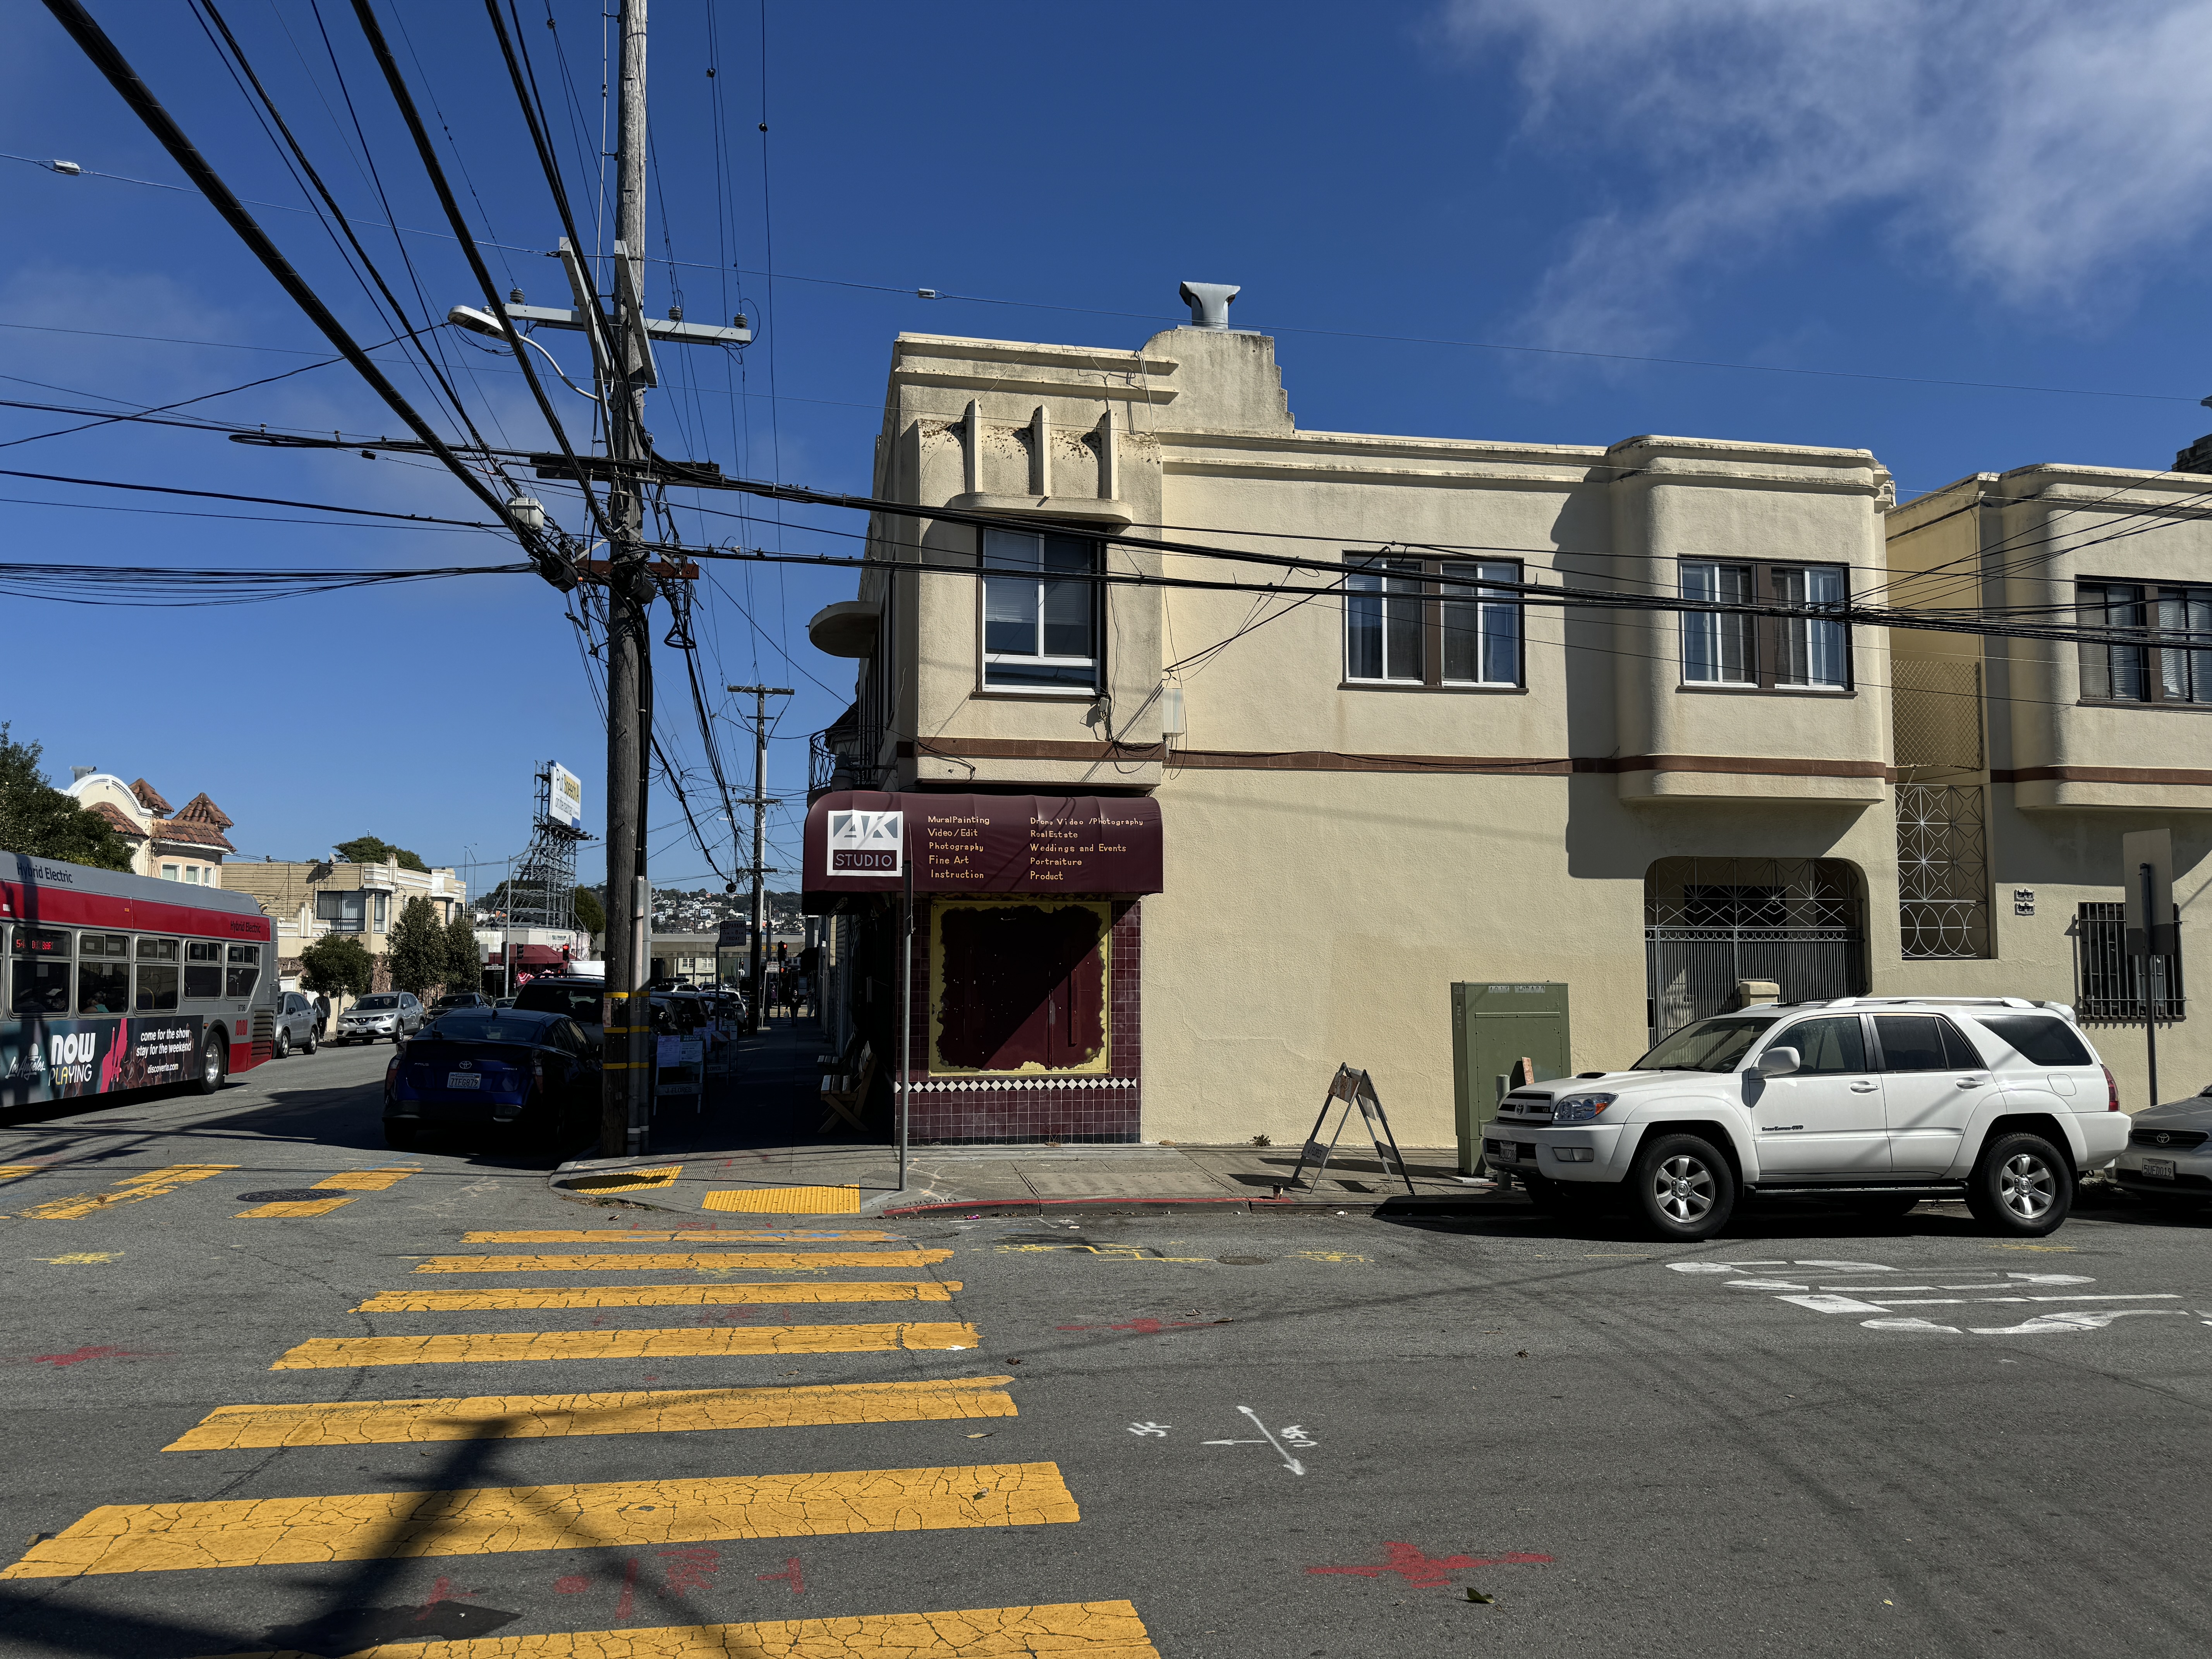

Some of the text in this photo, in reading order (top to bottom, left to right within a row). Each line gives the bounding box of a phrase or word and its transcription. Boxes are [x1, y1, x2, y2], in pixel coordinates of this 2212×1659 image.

[834, 815, 898, 838] AK
[1030, 817, 1053, 825] Drone
[929, 842, 984, 852] Photography
[1030, 843, 1075, 853] Weddings
[1099, 843, 1127, 852] Events
[835, 854, 893, 867] STUDIO
[929, 855, 969, 864] Fine Art
[1030, 857, 1082, 866] Portraiture
[17, 862, 73, 883] Hybrid Electric
[931, 869, 984, 879] Instruction
[1030, 871, 1064, 880] Product
[230, 921, 261, 933] Hybrid Electric
[141, 1028, 190, 1042] come for the show
[136, 1040, 192, 1059] stay for the weekend
[5, 1055, 46, 1081] Los Angeles
[147, 1063, 179, 1074] discoverla.com
[48, 1063, 92, 1086] PLAYING
[451, 1078, 478, 1086] 7TFG879
[2144, 1164, 2172, 1177] 5UFD019
